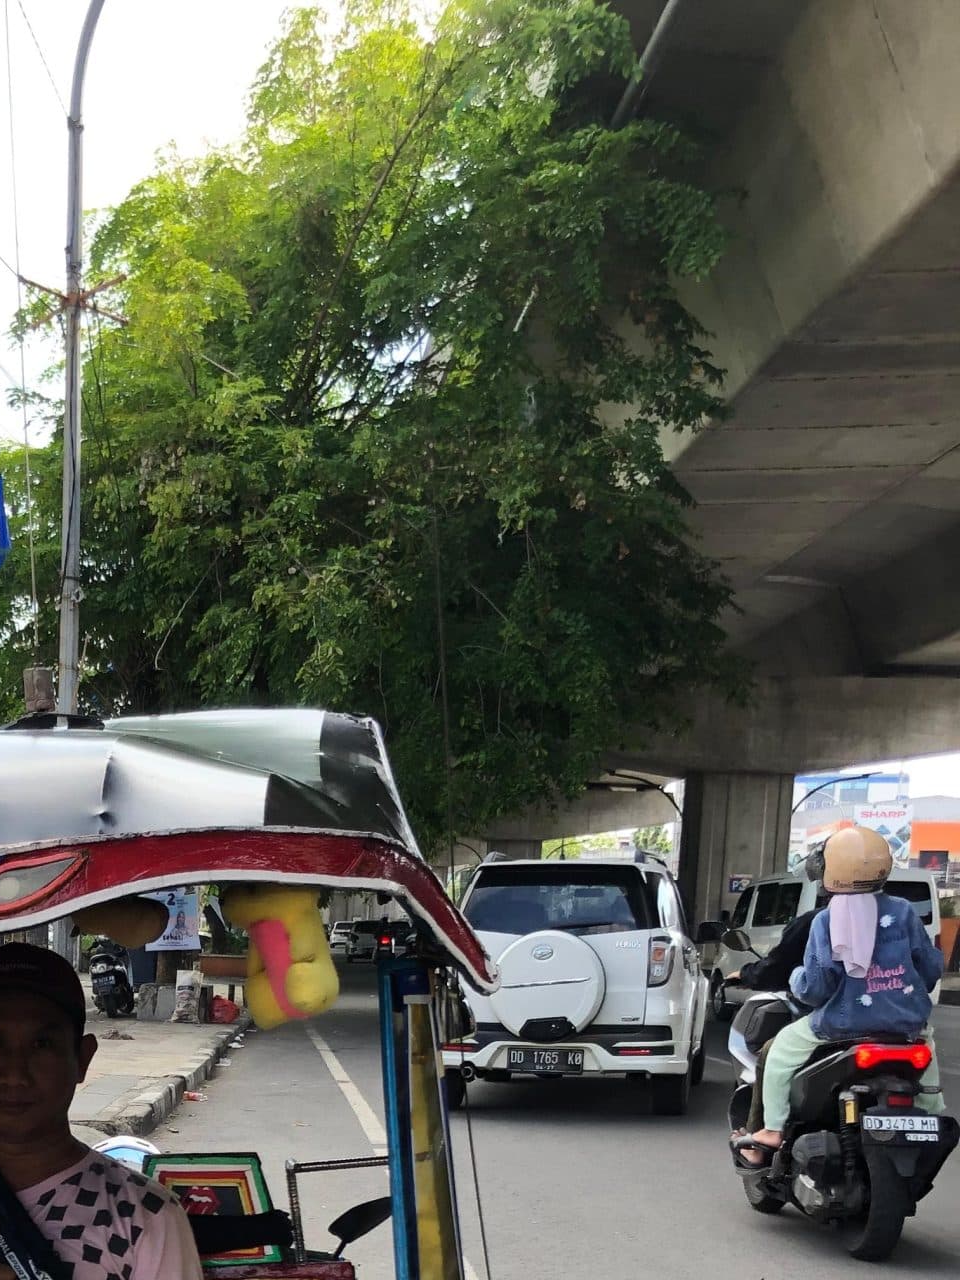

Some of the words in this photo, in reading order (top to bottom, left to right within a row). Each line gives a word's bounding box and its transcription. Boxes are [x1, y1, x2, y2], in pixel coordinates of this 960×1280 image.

[860, 810, 906, 819] SHARP
[511, 1051, 524, 1063] DD
[534, 1052, 559, 1064] 1765
[886, 1119, 914, 1129] 3479
[921, 1120, 936, 1129] MH
